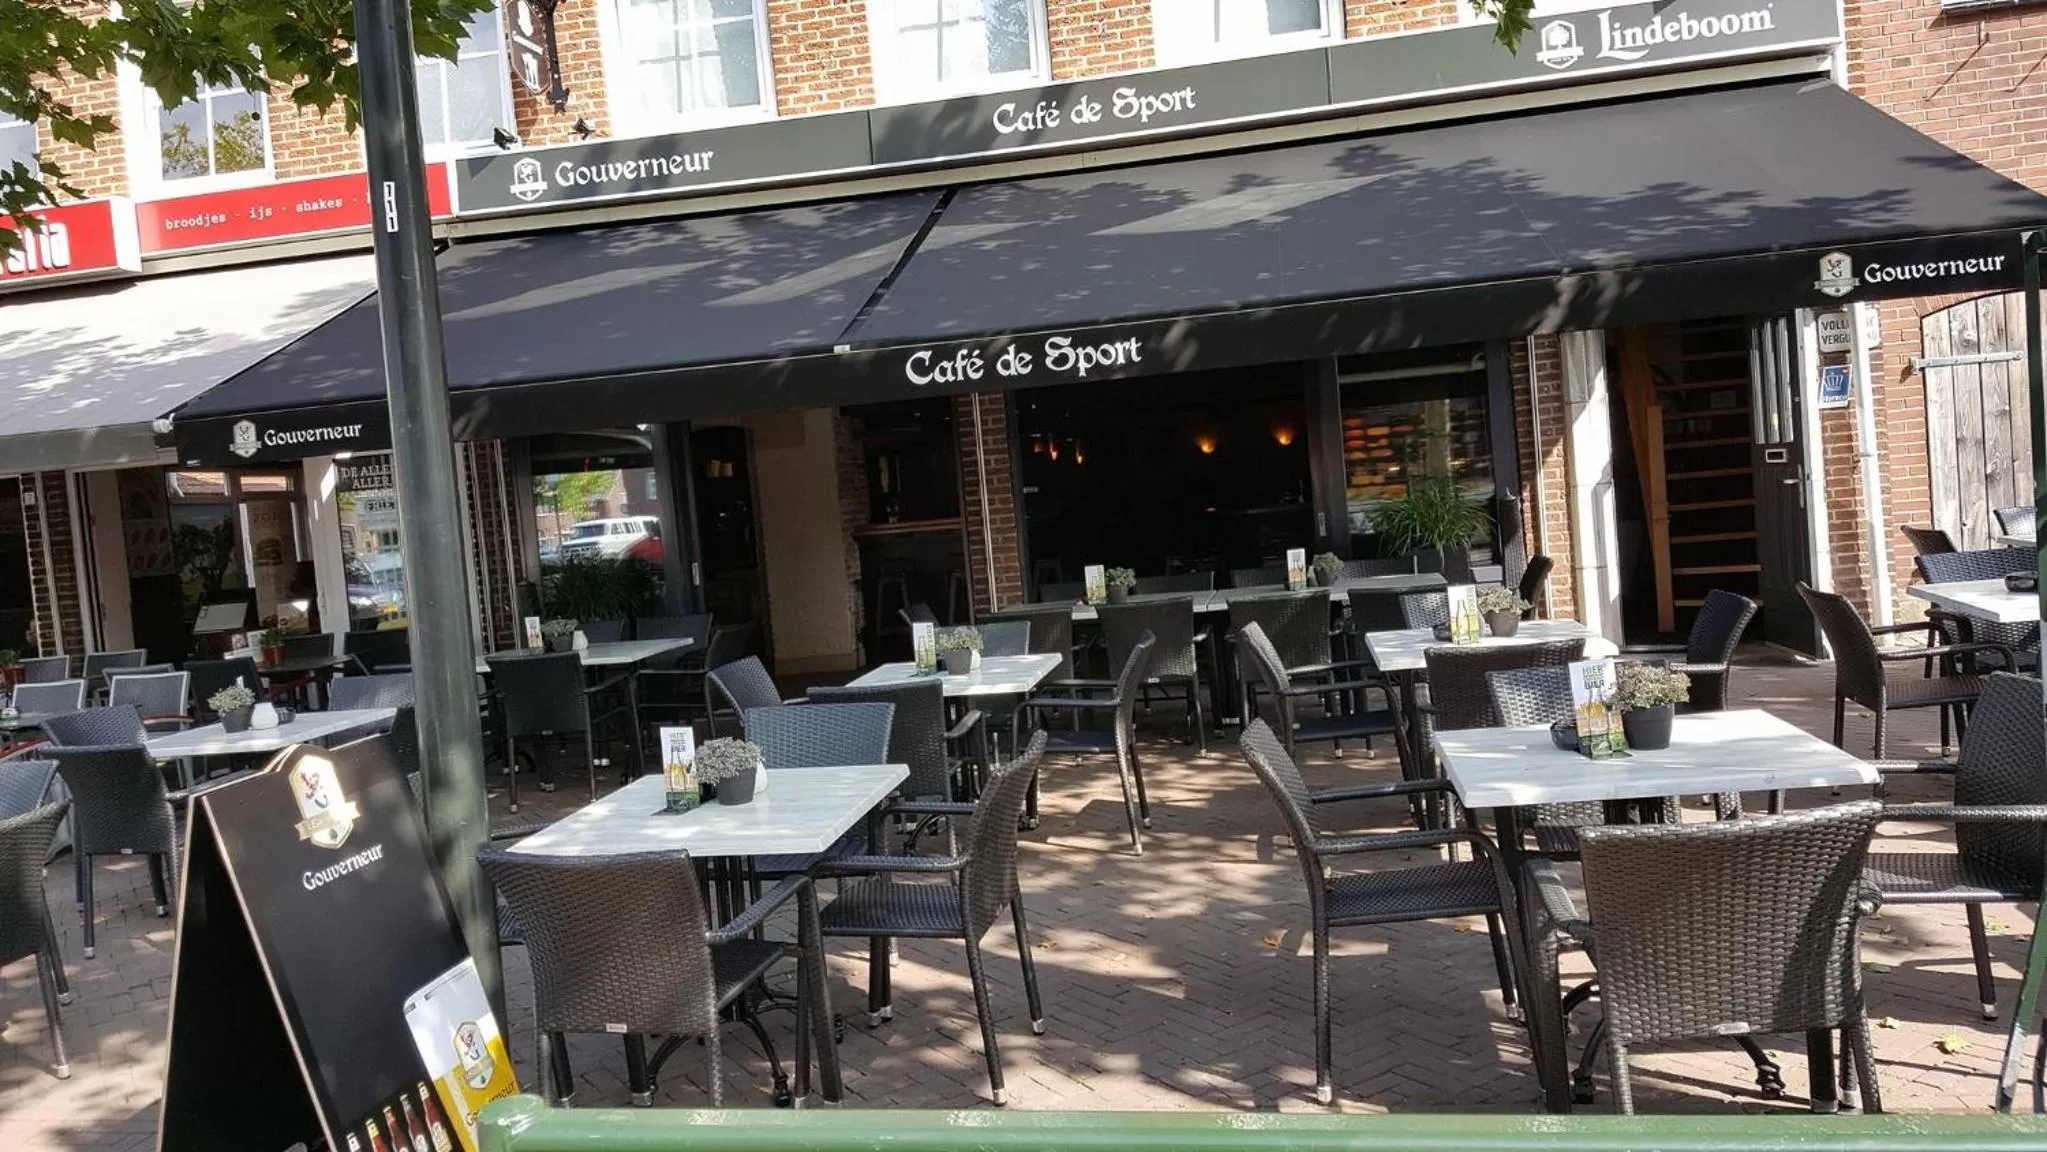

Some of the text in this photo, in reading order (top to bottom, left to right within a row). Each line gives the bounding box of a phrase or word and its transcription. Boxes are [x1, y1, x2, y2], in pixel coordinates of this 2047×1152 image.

[1596, 8, 1776, 61] Lindeboom
[993, 86, 1196, 134] Café de Sport
[555, 151, 715, 187] Gouverneur
[164, 197, 344, 231] broodjes ijs shakes
[1864, 255, 2006, 284] Gouverneur
[905, 336, 1142, 385] Café de Sport
[264, 423, 362, 447] Gouverneur
[302, 843, 384, 891] Gouverneur
